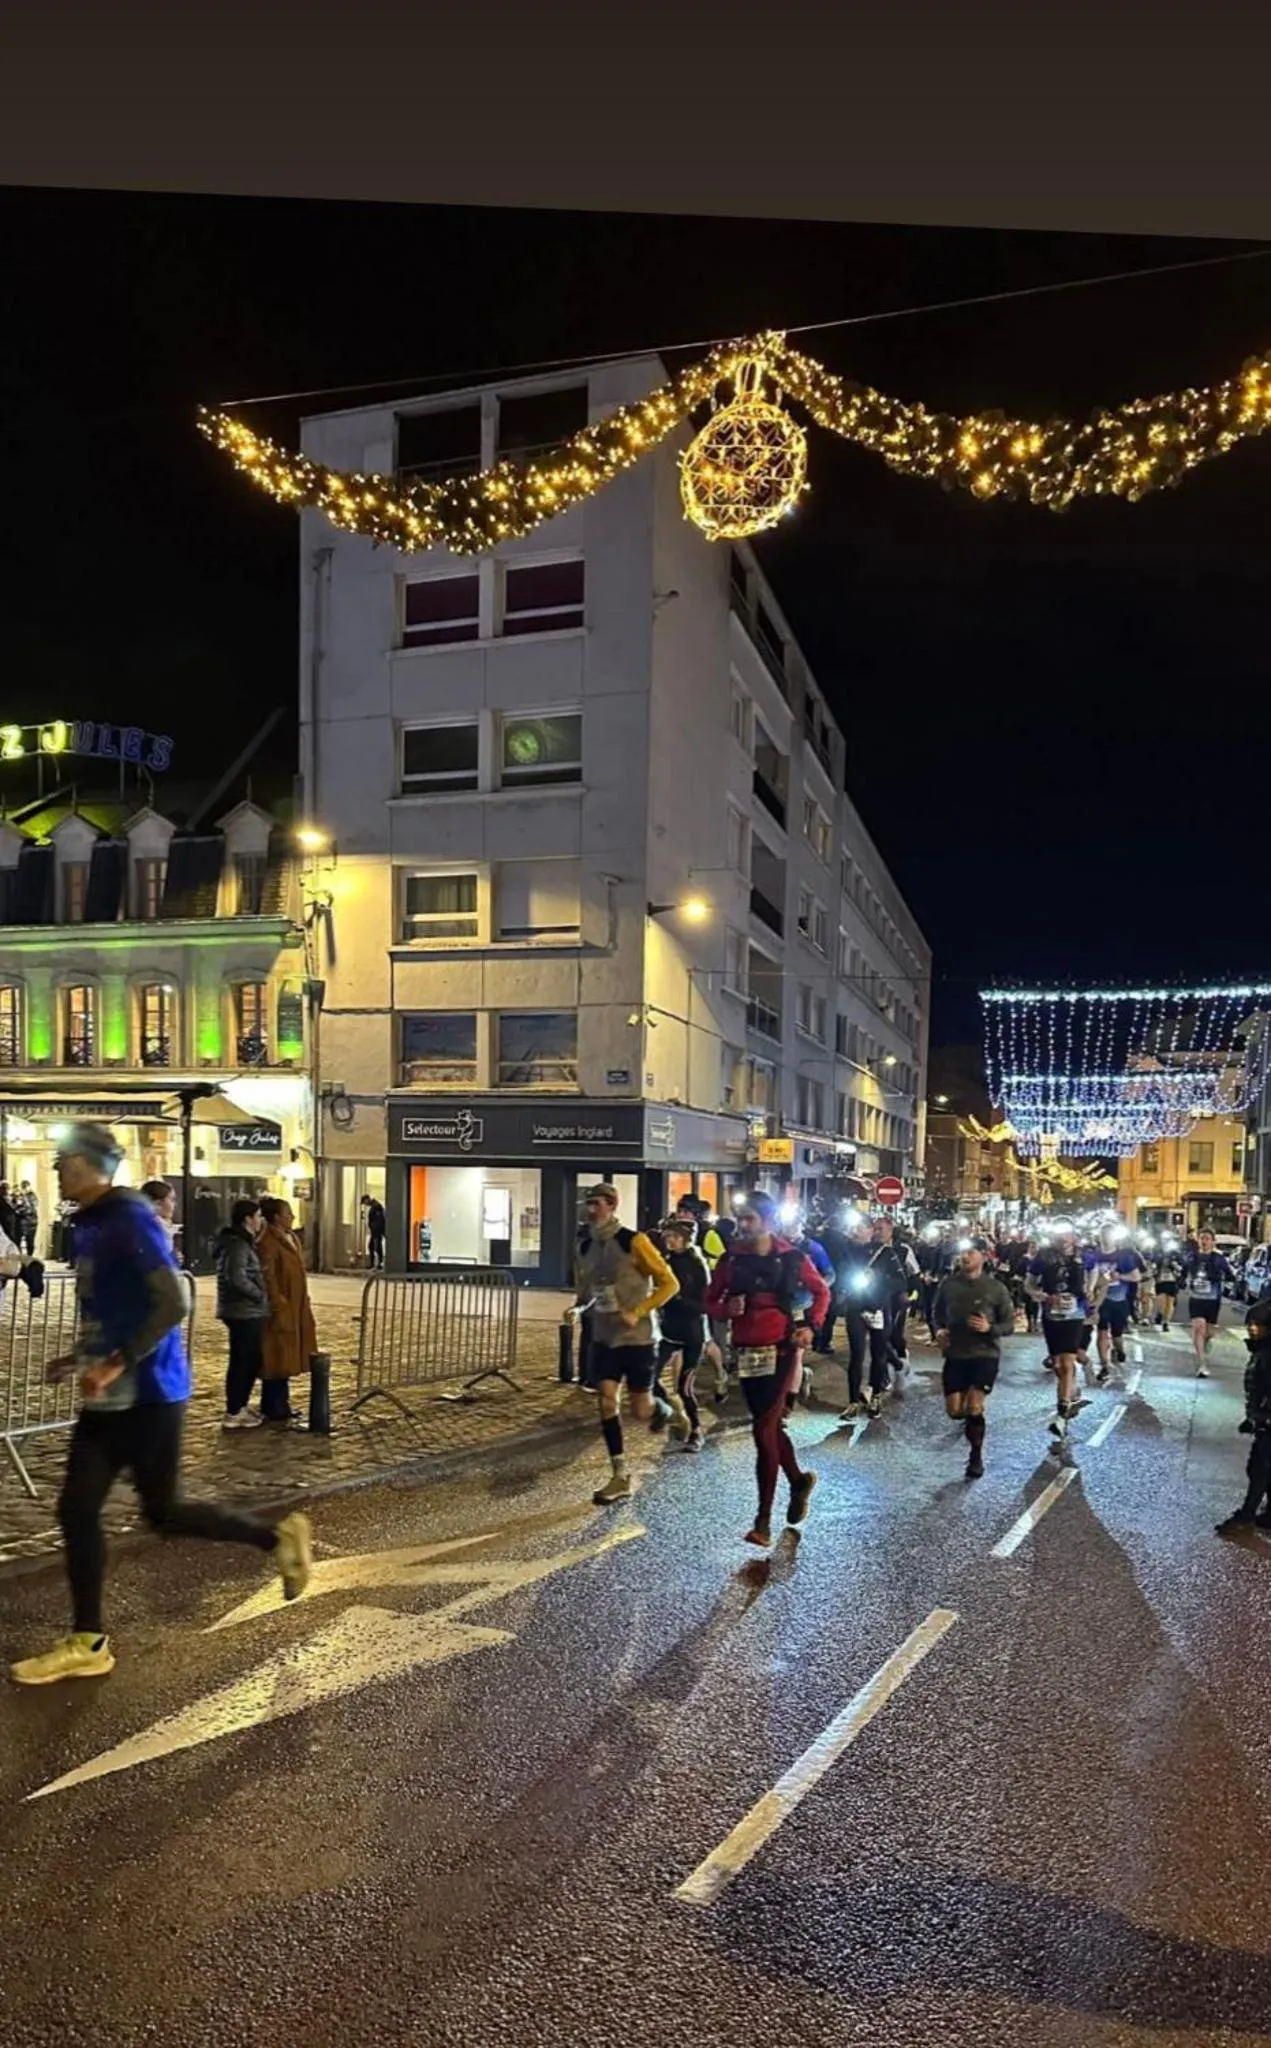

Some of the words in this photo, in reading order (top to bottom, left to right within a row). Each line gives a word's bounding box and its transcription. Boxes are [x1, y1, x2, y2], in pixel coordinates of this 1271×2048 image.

[42, 719, 174, 771] JULES
[407, 1123, 456, 1135] Selectour
[532, 1124, 576, 1138] Voyages
